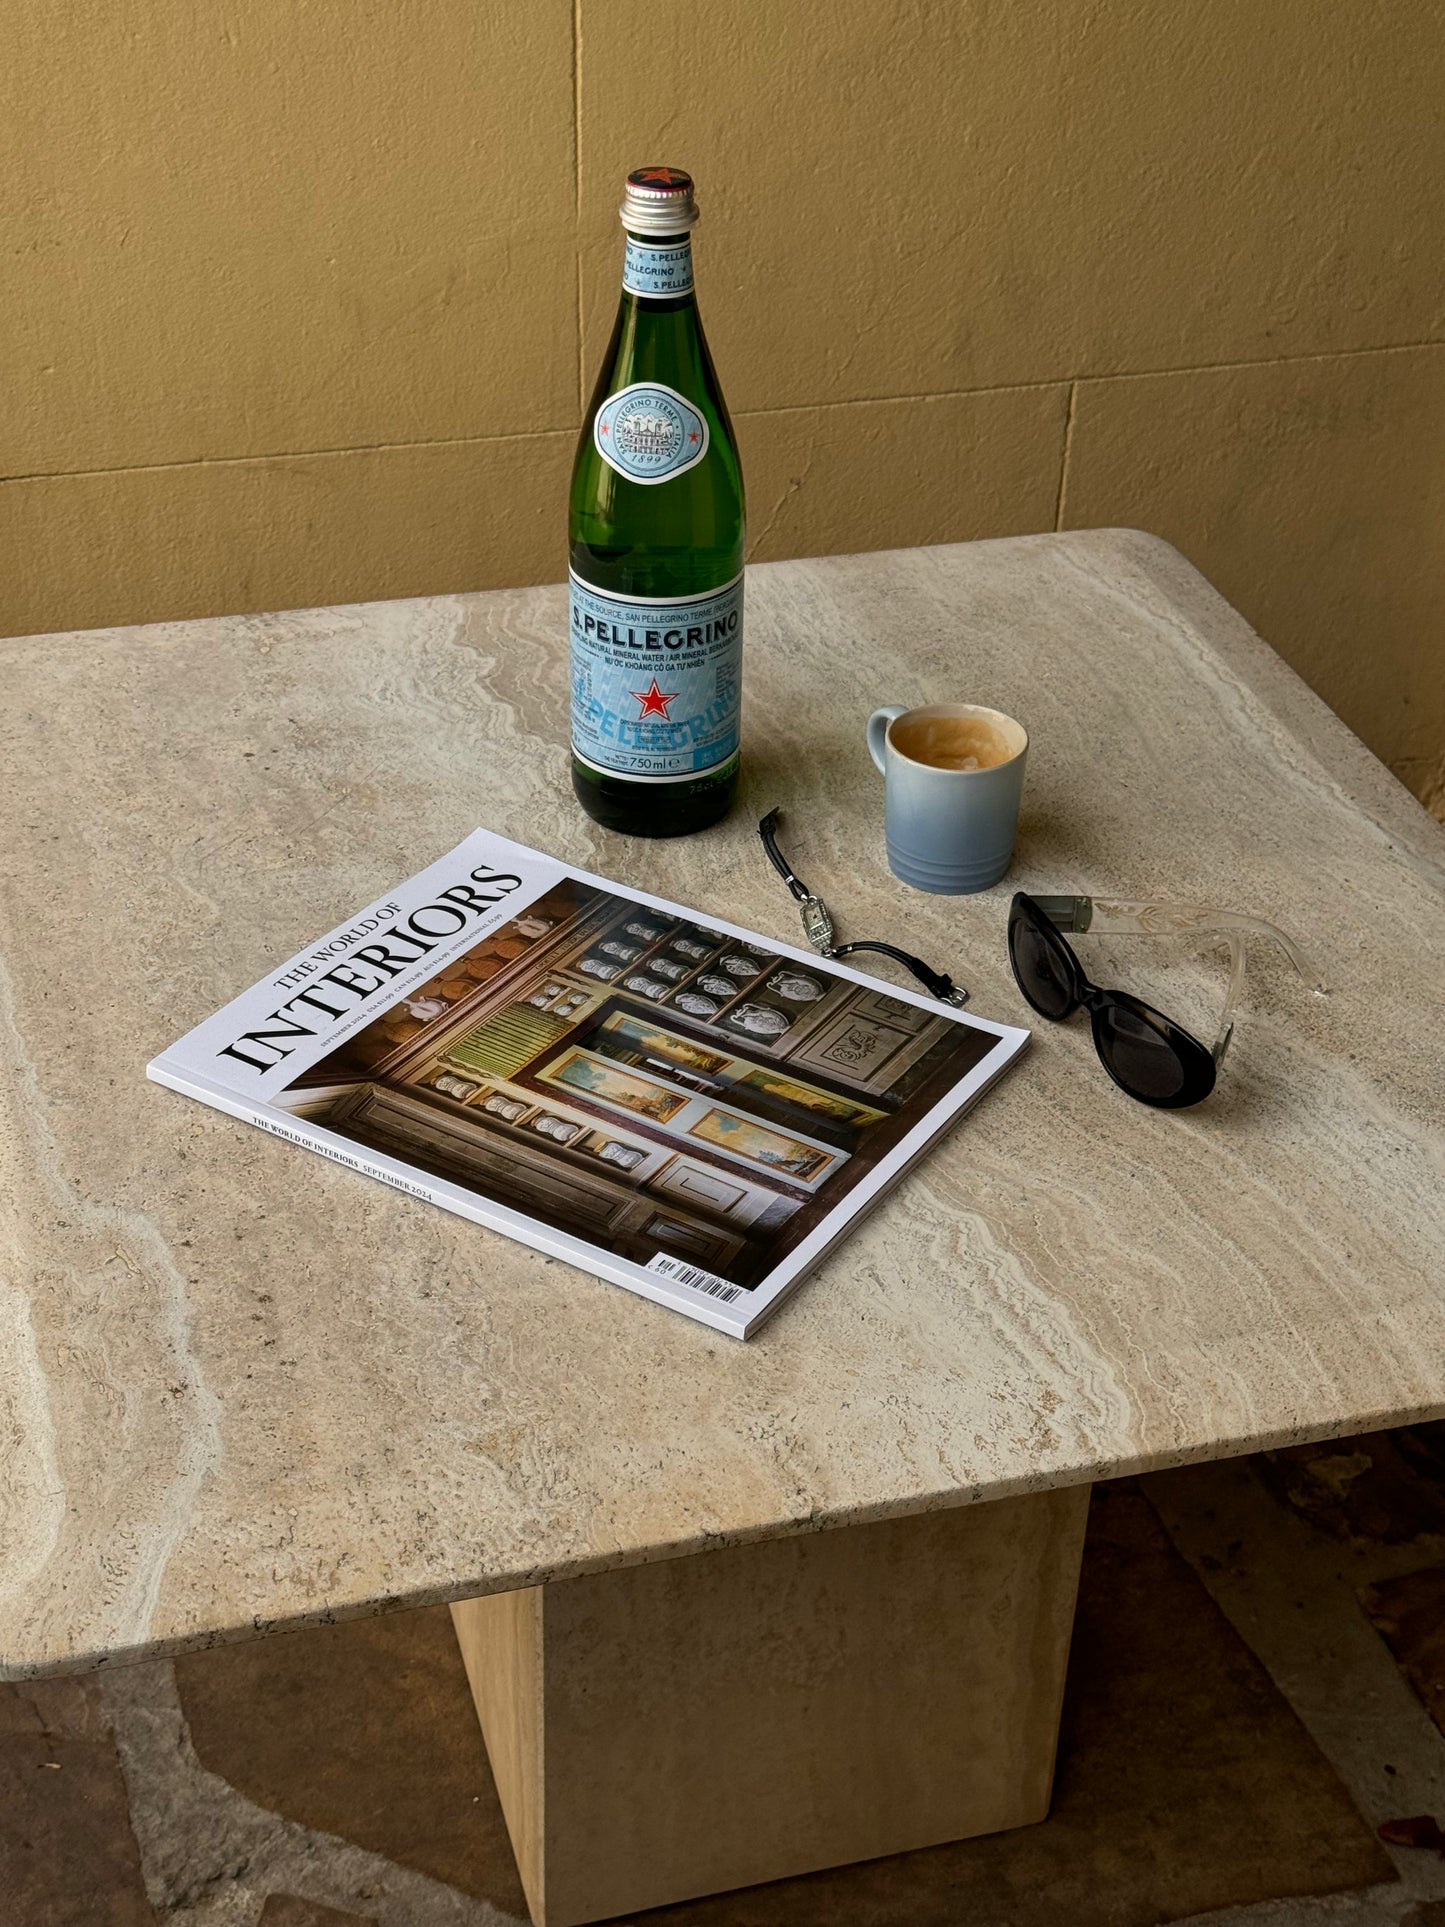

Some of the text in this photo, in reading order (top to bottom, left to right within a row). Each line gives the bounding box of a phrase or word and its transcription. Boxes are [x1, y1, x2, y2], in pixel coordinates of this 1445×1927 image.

[616, 399, 652, 434] PELLEGRINO
[655, 400, 679, 423] TERME
[631, 454, 662, 464] 1899
[573, 604, 738, 651] S.PELLEGRINO
[625, 613, 641, 622] SAN
[641, 613, 689, 624] PELLEGRINO
[690, 607, 713, 620] TERME
[588, 640, 612, 656] NATURAL
[612, 649, 640, 661] MINERAL
[641, 653, 664, 662] WATER
[670, 653, 681, 661] AIR
[681, 647, 707, 660] MINERAL
[665, 664, 675, 672] GA
[630, 757, 652, 769] 750
[653, 757, 666, 769] ml
[272, 901, 403, 992] THE WORLD OF
[215, 864, 524, 1077] INTERIORS
[320, 1022, 352, 1048] SEPTEMBER
[252, 1116, 433, 1201] THE WORLD OF INTERIORS SEPTEMBER 2024
